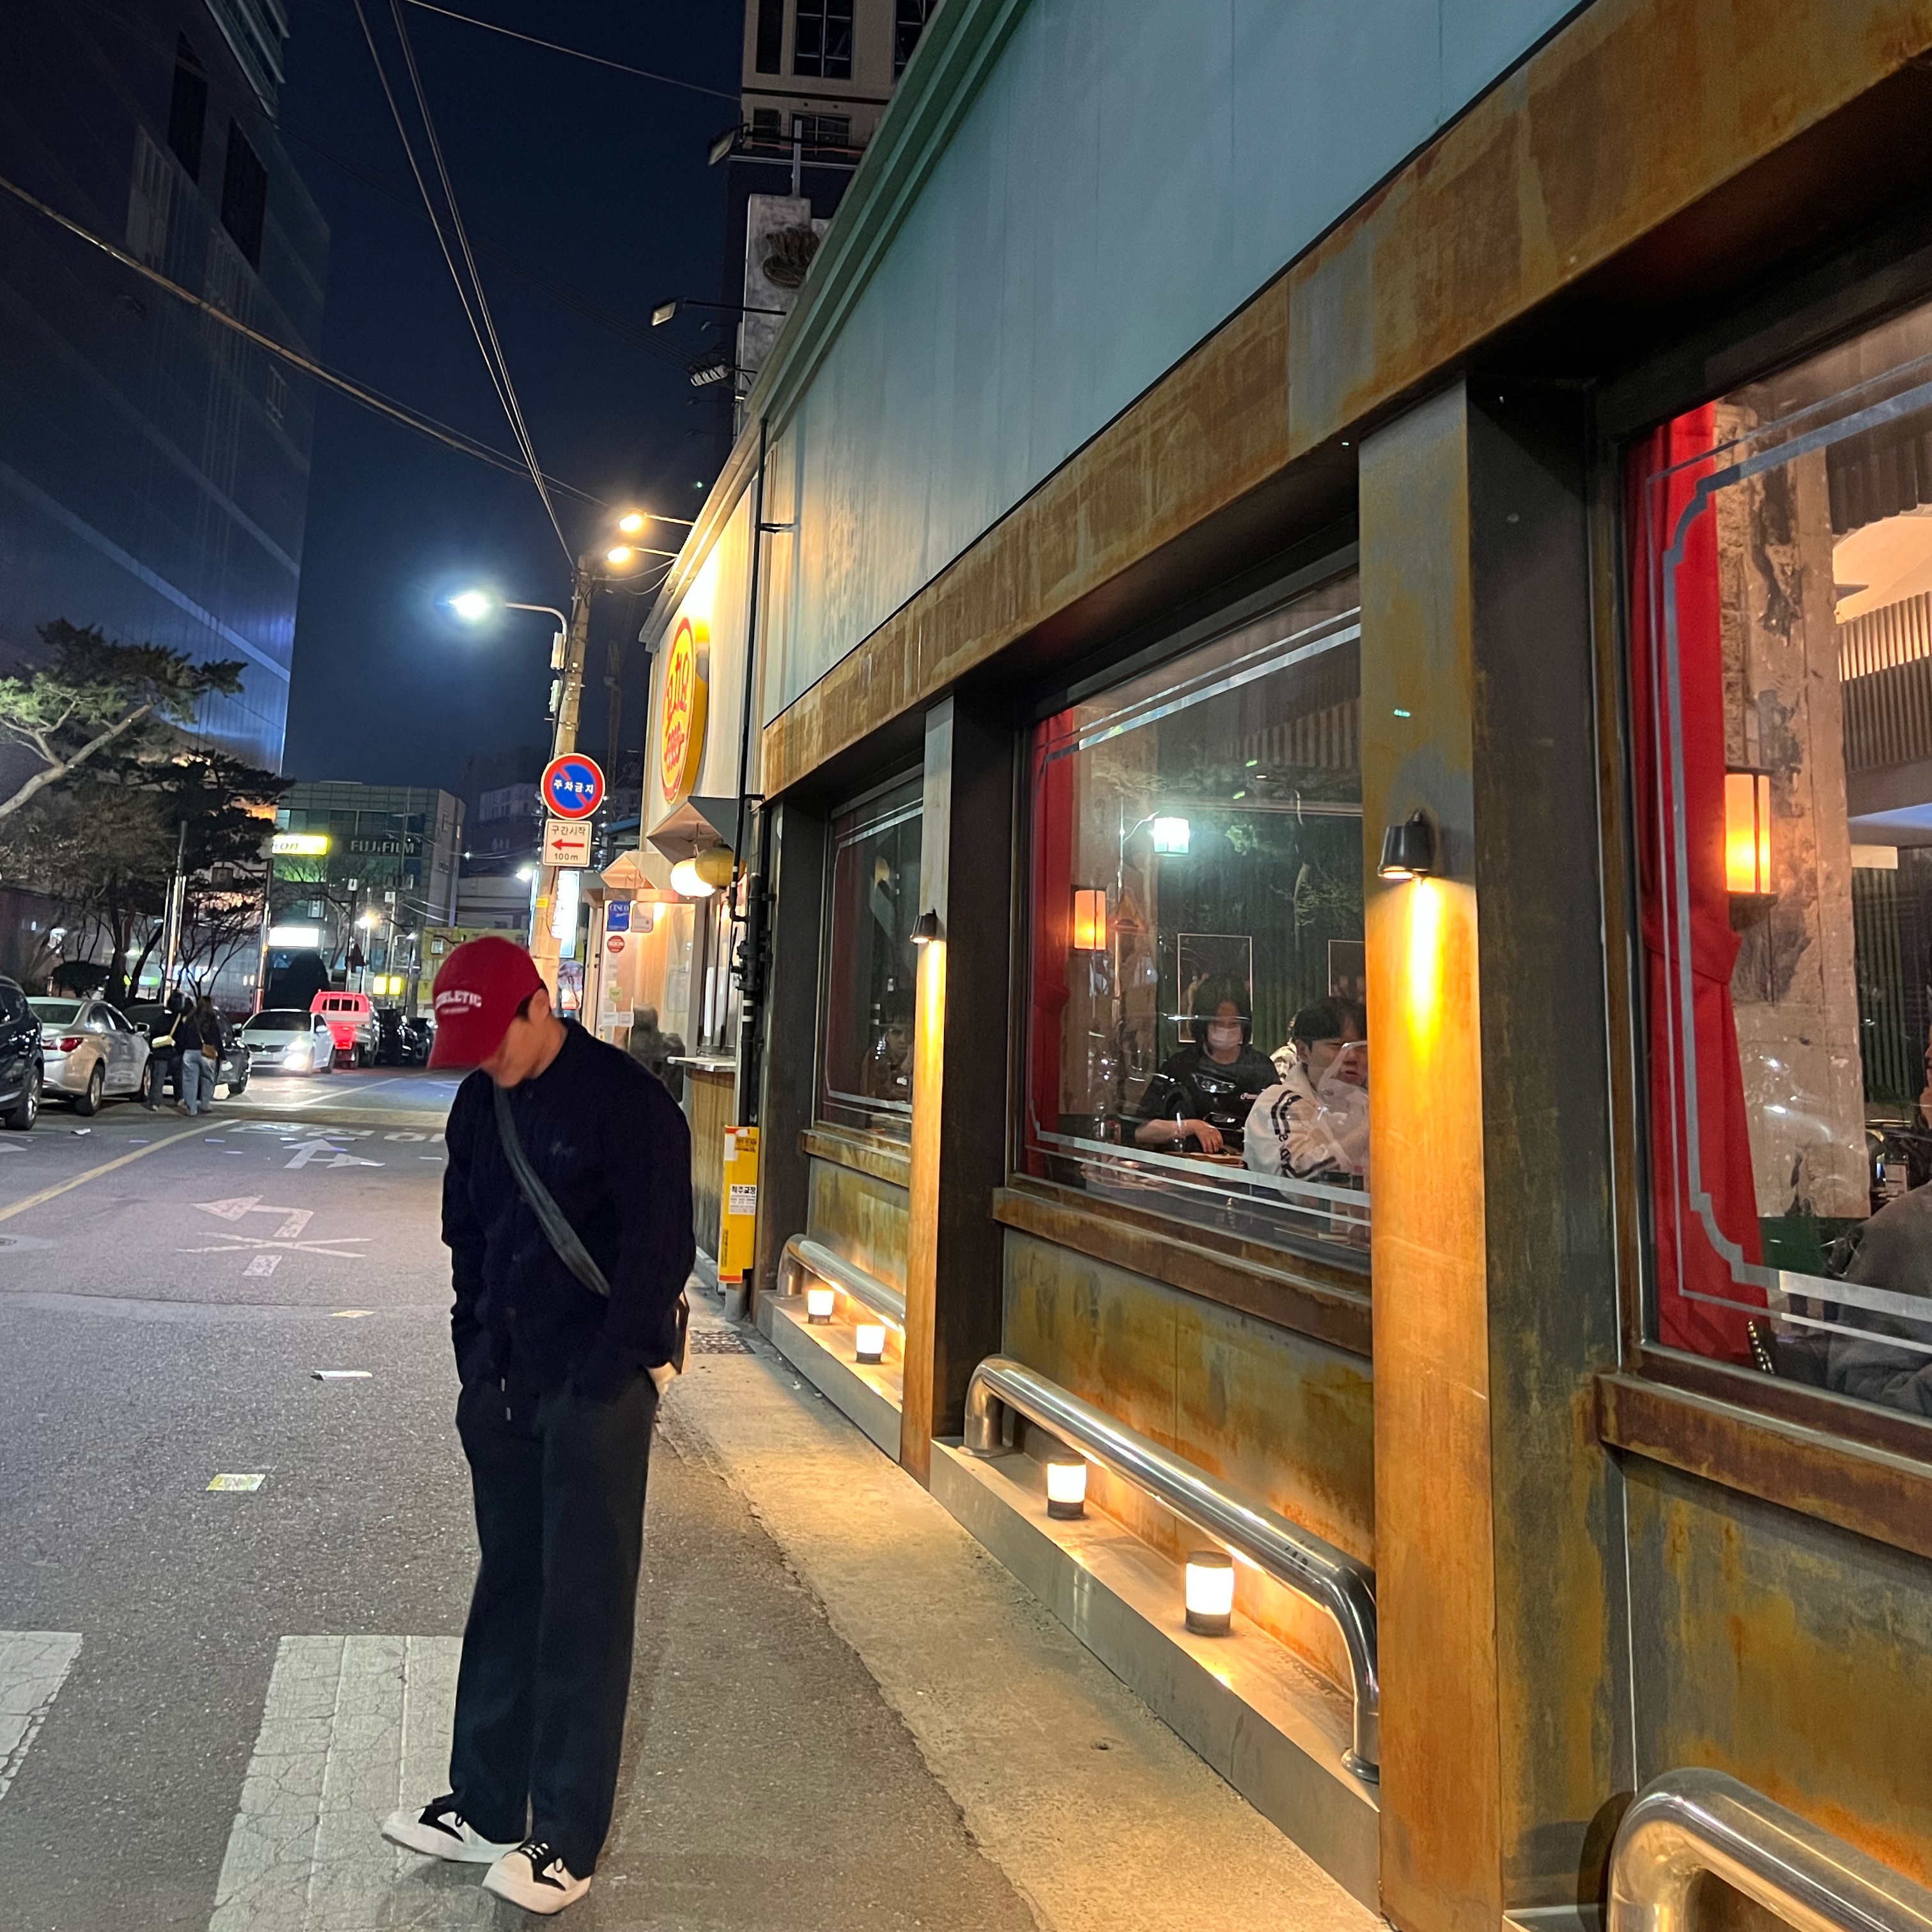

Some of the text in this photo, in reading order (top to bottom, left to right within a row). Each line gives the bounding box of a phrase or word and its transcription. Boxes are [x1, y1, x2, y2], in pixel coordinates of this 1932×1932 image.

[553, 779, 594, 794] 주차금지
[551, 825, 586, 836] 구간시작
[554, 853, 579, 861] 100m
